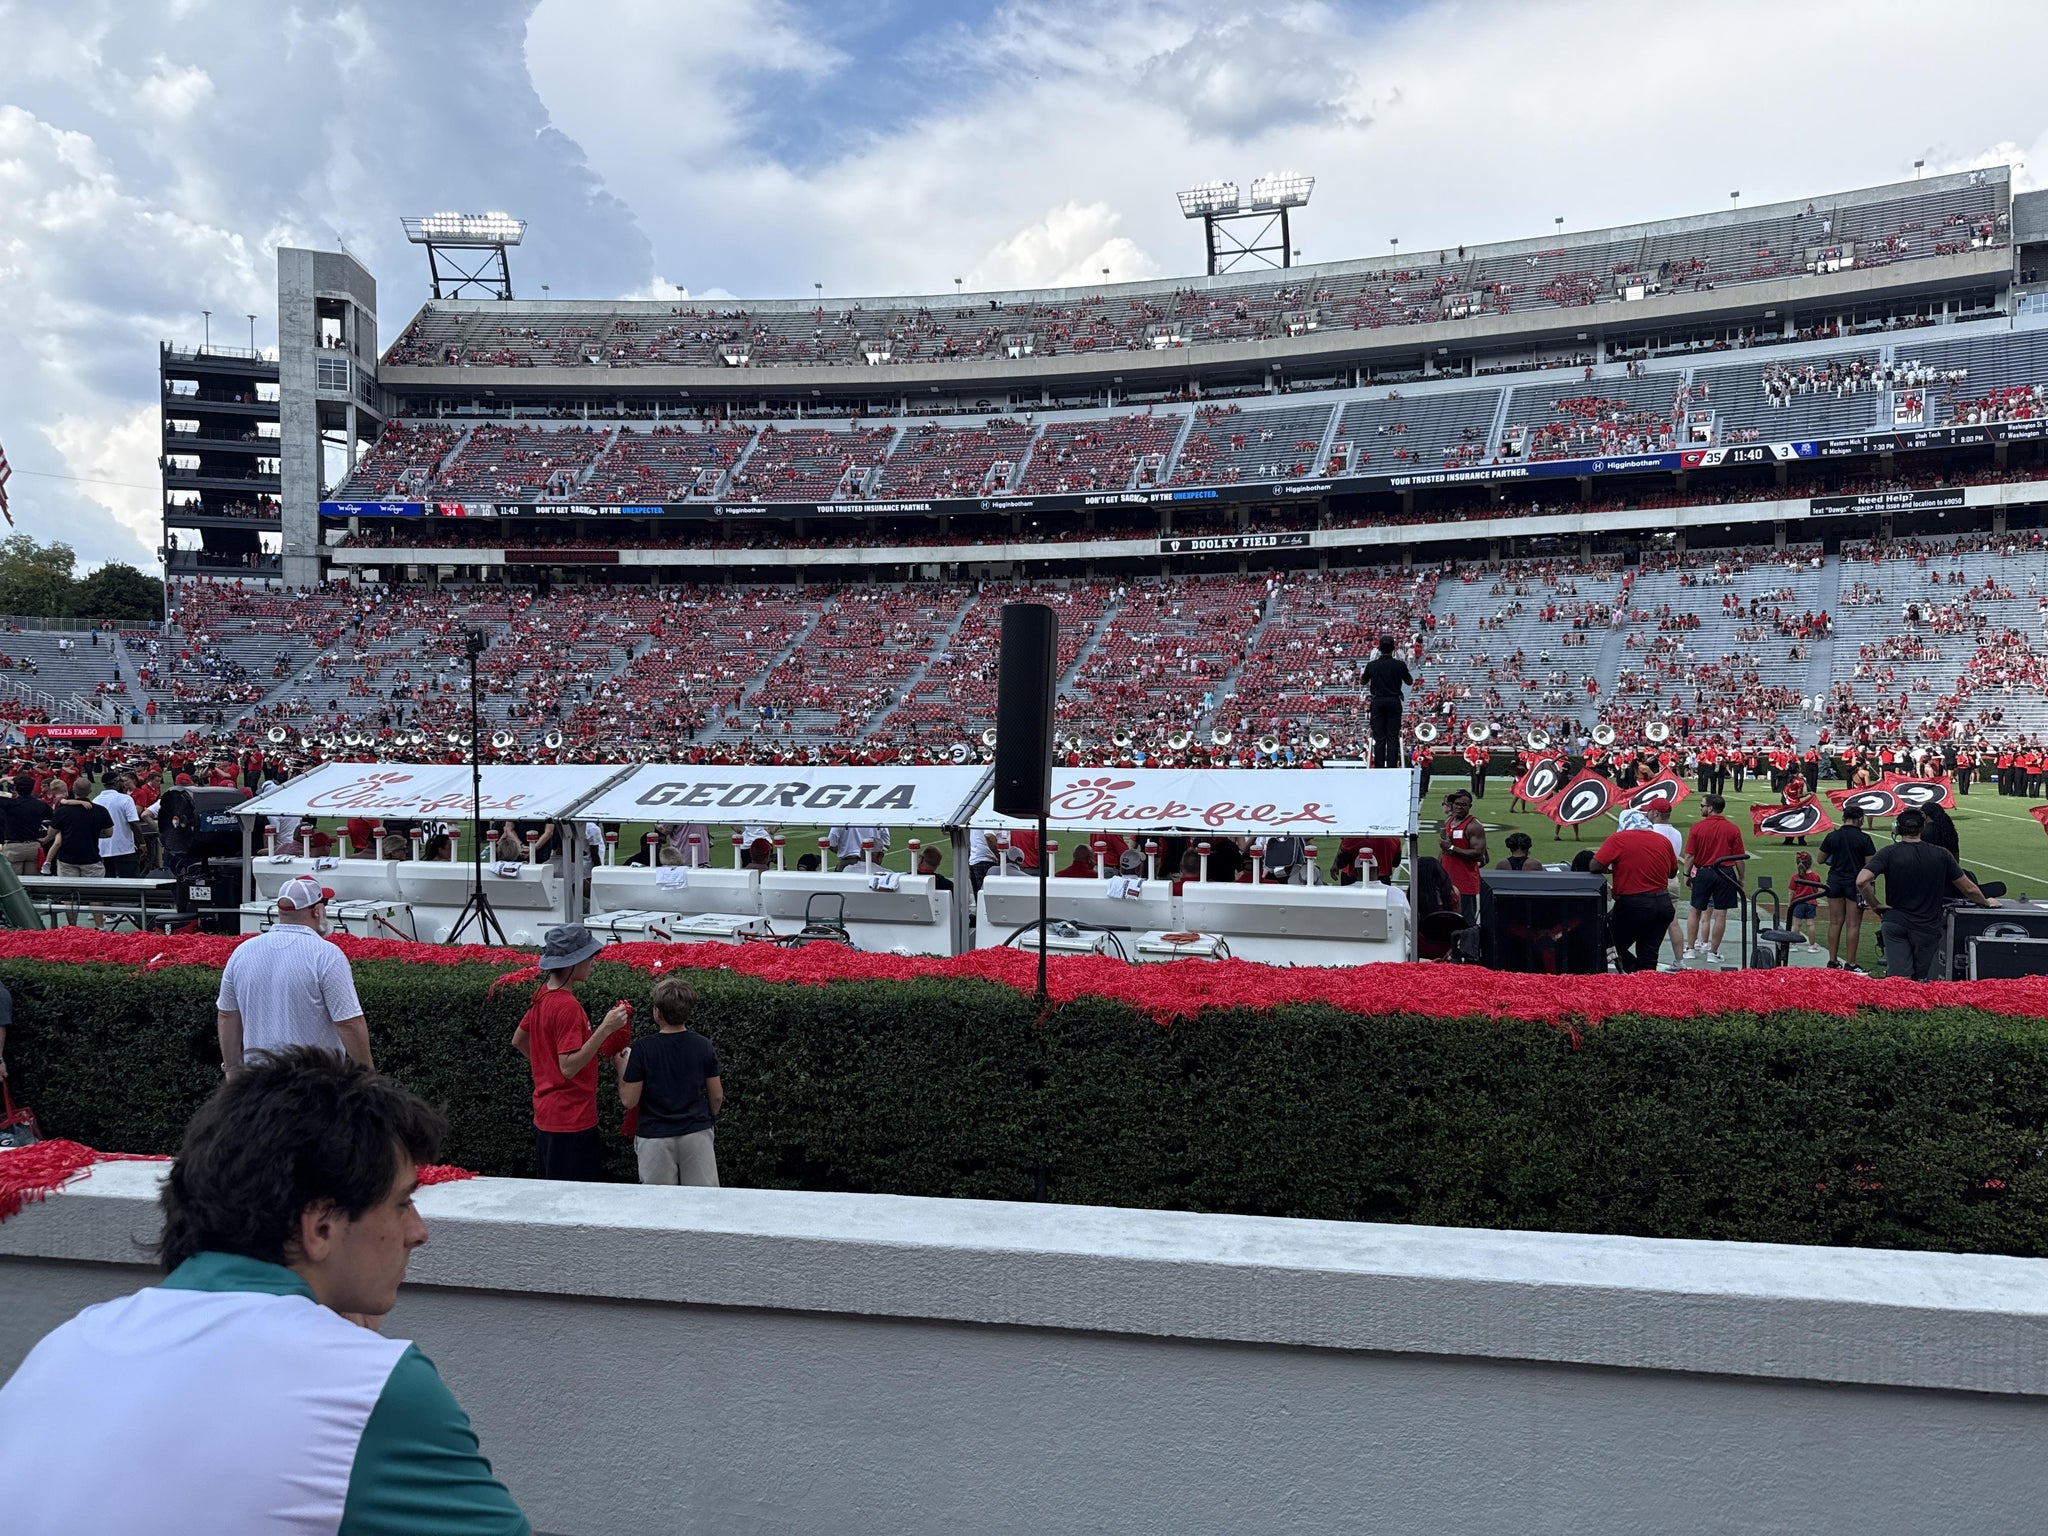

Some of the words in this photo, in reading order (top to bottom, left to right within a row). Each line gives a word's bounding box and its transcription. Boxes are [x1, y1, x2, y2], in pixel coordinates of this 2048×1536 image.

[1734, 449, 1762, 461] 11:40
[1781, 447, 1788, 457] 3
[1707, 453, 1720, 463] 35
[1607, 460, 1660, 469] Higginbotham
[1390, 477, 1410, 486] YOUR
[1412, 474, 1445, 484] TRUSTED
[1447, 471, 1490, 482] INSURANCE
[1492, 468, 1528, 478] PARTNER.
[1285, 485, 1331, 493] Higginbotham
[1886, 494, 1914, 503] Help?
[1191, 538, 1237, 549] DOOLEY
[1242, 537, 1277, 547] FIELD
[635, 782, 916, 809] GEORGIA
[1049, 778, 1338, 826] Chick-fil-A
